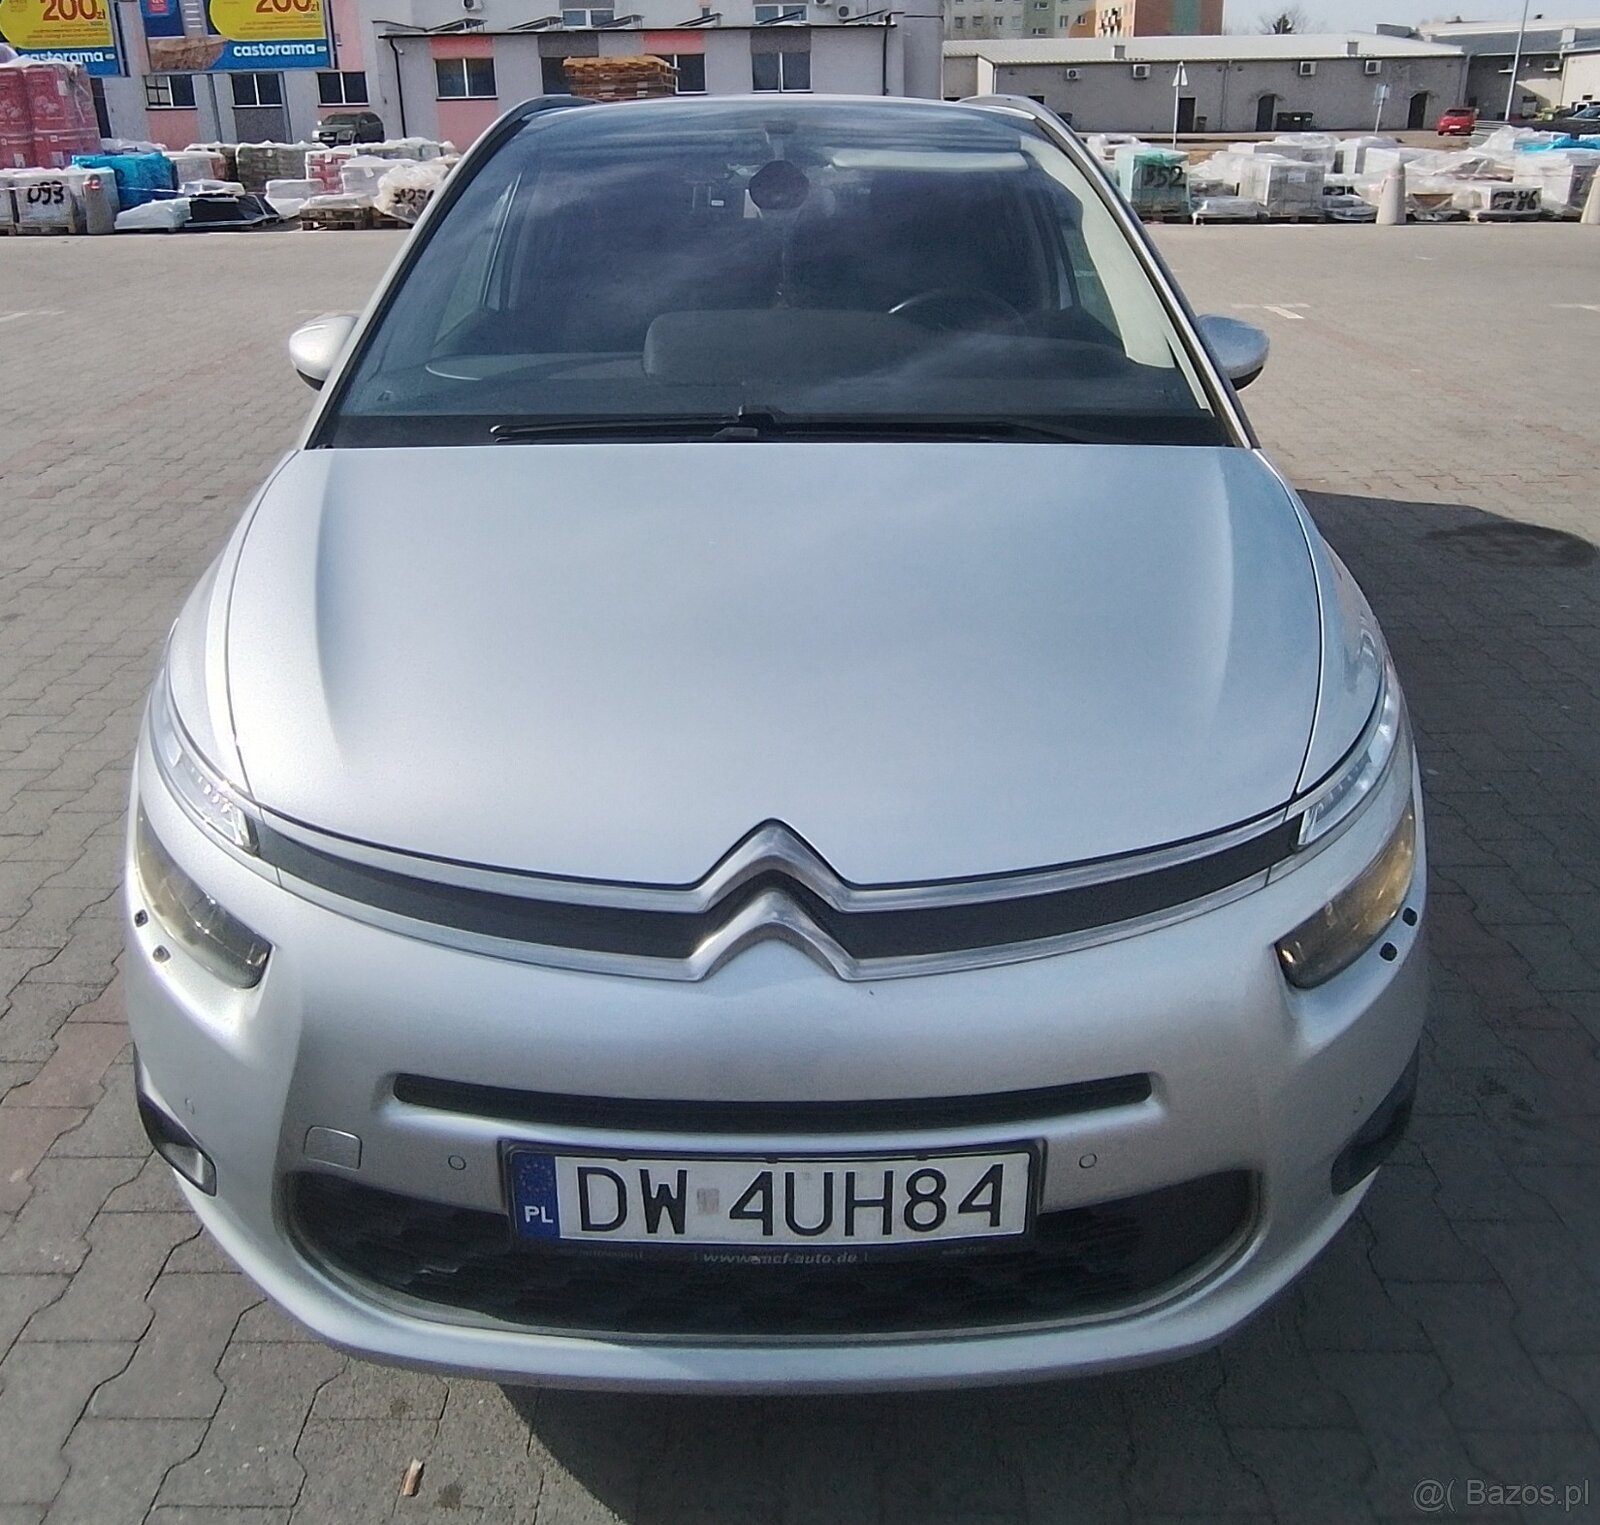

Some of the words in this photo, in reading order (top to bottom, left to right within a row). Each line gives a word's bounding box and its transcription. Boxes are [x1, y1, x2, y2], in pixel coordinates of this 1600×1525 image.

[24, 51, 104, 63] astorama
[233, 43, 316, 57] castorama
[577, 1166, 688, 1235] DW
[729, 1163, 1004, 1237] 4UH84
[524, 1205, 554, 1223] PL
